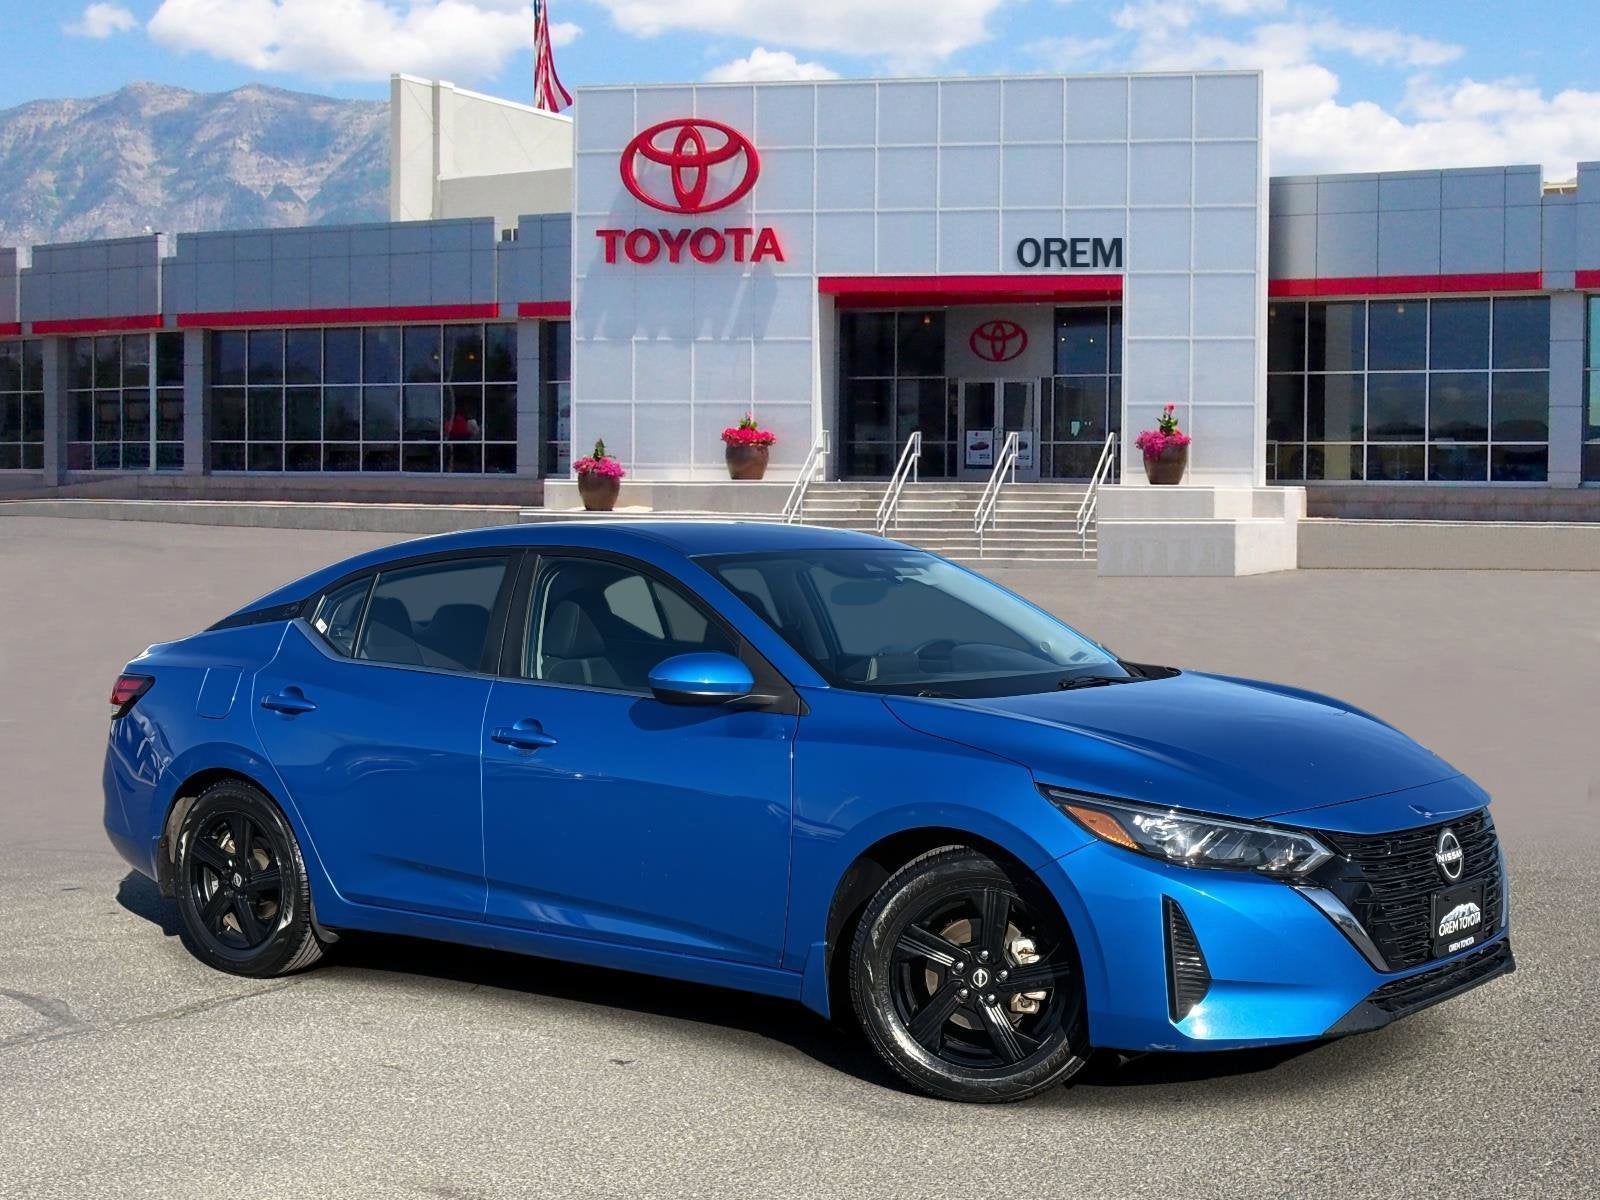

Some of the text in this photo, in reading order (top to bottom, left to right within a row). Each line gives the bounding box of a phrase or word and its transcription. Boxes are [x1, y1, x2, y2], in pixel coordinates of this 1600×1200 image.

[596, 227, 784, 264] TOYOTA
[1016, 237, 1123, 269] OREM
[1436, 849, 1462, 864] NISSAN
[1439, 912, 1481, 936] OREM TOYOTA
